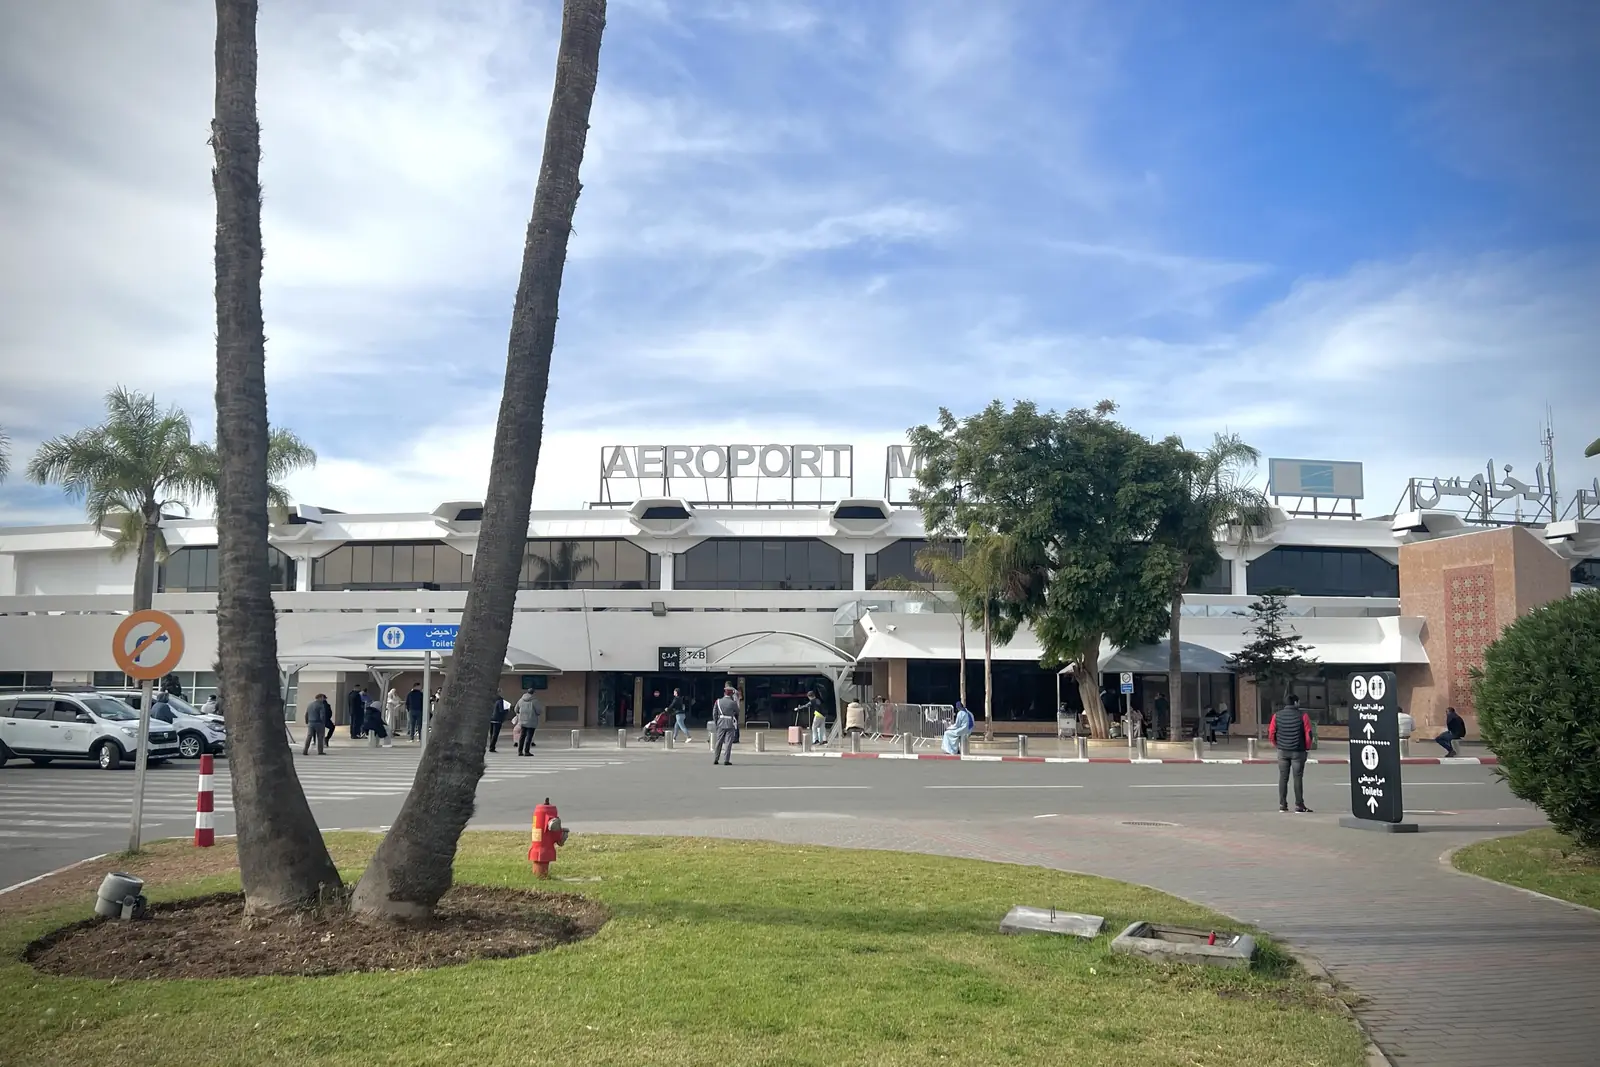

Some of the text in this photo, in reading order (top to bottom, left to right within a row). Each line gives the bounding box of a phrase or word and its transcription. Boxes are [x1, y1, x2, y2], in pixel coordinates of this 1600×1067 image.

[605, 444, 852, 478] AEROPORT
[425, 628, 458, 637] راحيض
[1353, 703, 1385, 712] موقف السيارات
[1359, 713, 1377, 721] Parking
[1358, 774, 1385, 785] مراحيض
[1361, 786, 1383, 796] Toilets
